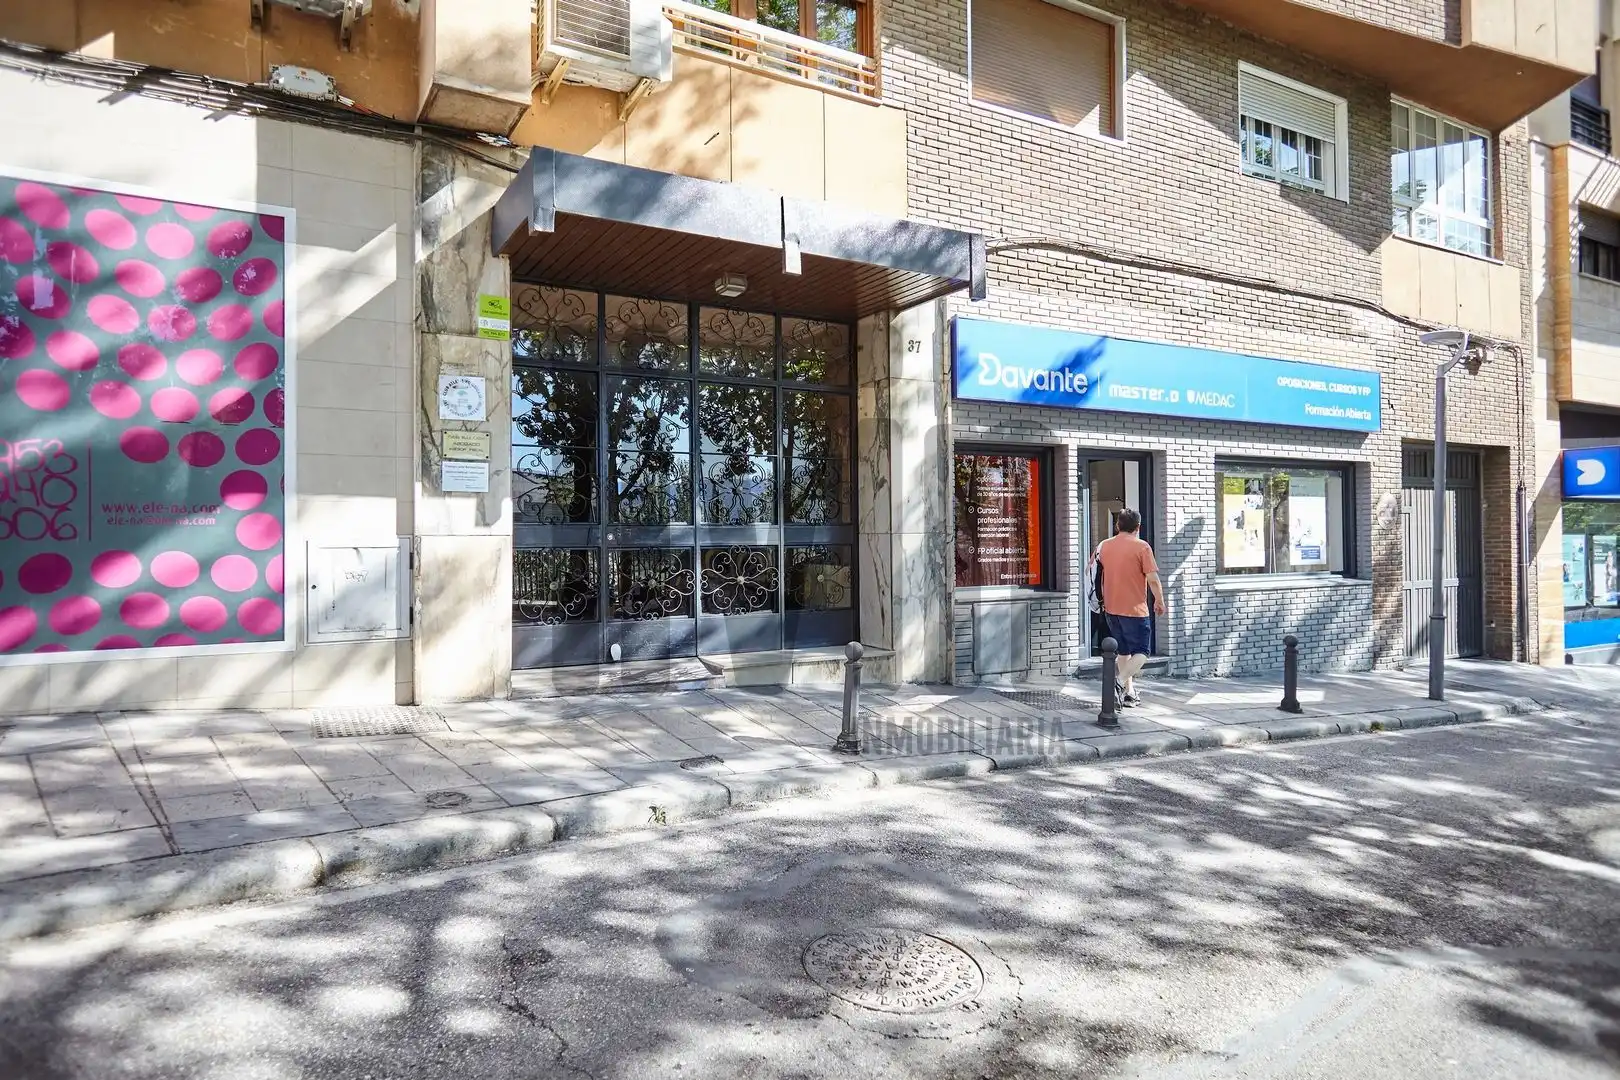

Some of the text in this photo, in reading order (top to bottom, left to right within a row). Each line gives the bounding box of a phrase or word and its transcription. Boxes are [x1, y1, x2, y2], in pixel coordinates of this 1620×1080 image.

[908, 339, 921, 353] 37
[978, 352, 1089, 394] Davante
[1195, 391, 1236, 408] MEDAC
[1329, 383, 1357, 395] CURSOS
[1363, 386, 1371, 396] FP
[1304, 403, 1372, 420] Formación Abierta
[977, 516, 1017, 525] profesionales
[986, 546, 1005, 555] oficial
[1005, 546, 1026, 554] abierta
